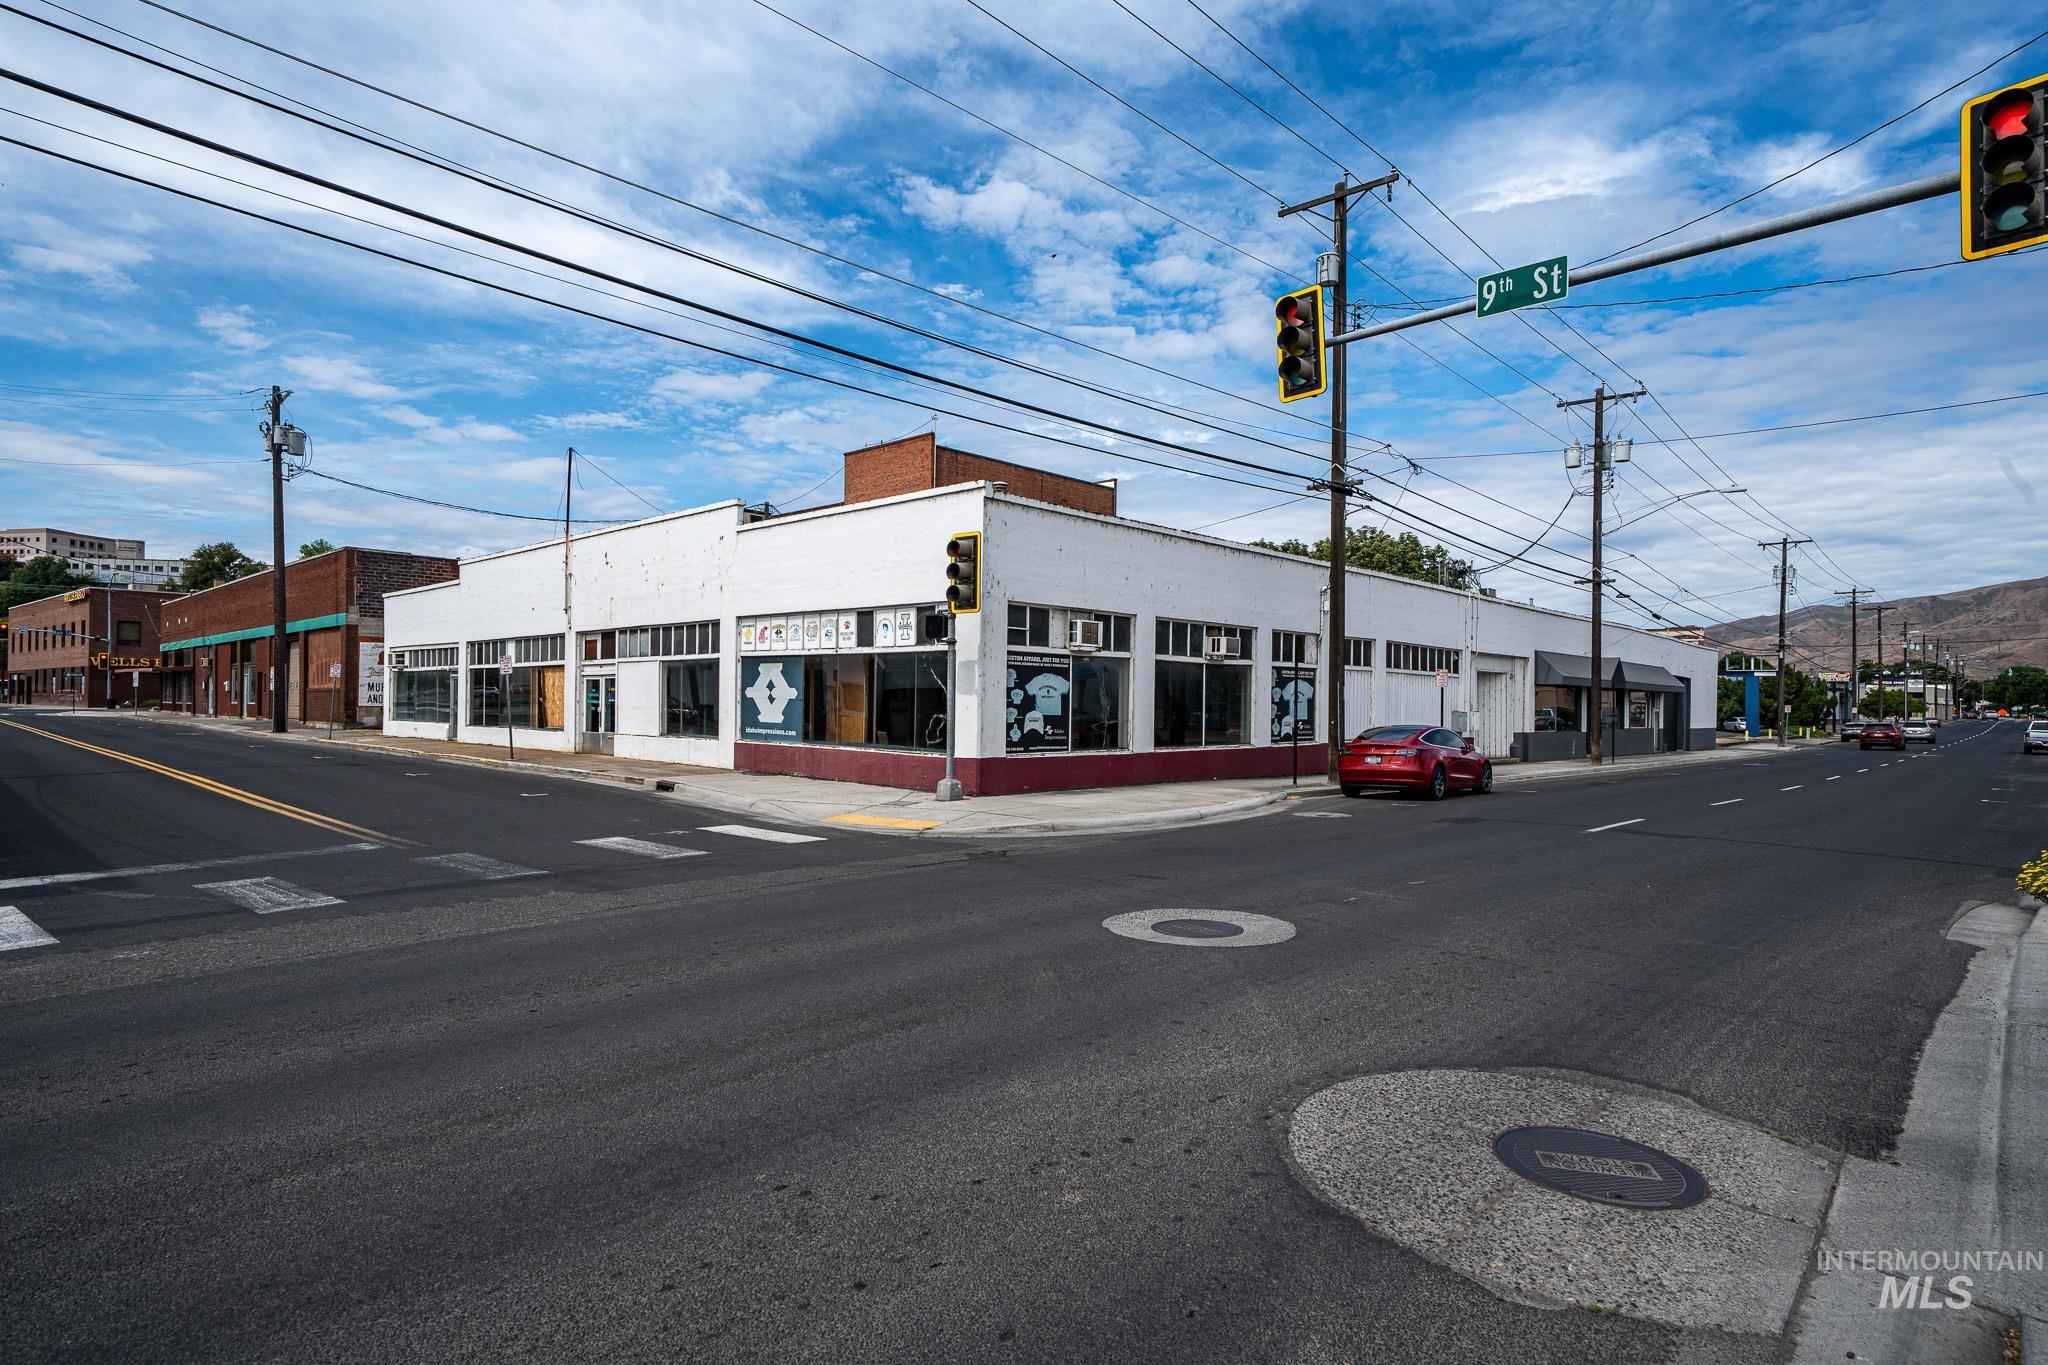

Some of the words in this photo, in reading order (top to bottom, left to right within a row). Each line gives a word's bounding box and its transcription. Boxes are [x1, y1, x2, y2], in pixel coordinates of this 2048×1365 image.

[1482, 276, 1514, 312] 9th
[1533, 263, 1562, 299] St
[1548, 1158, 1639, 1178] LEWISTON
